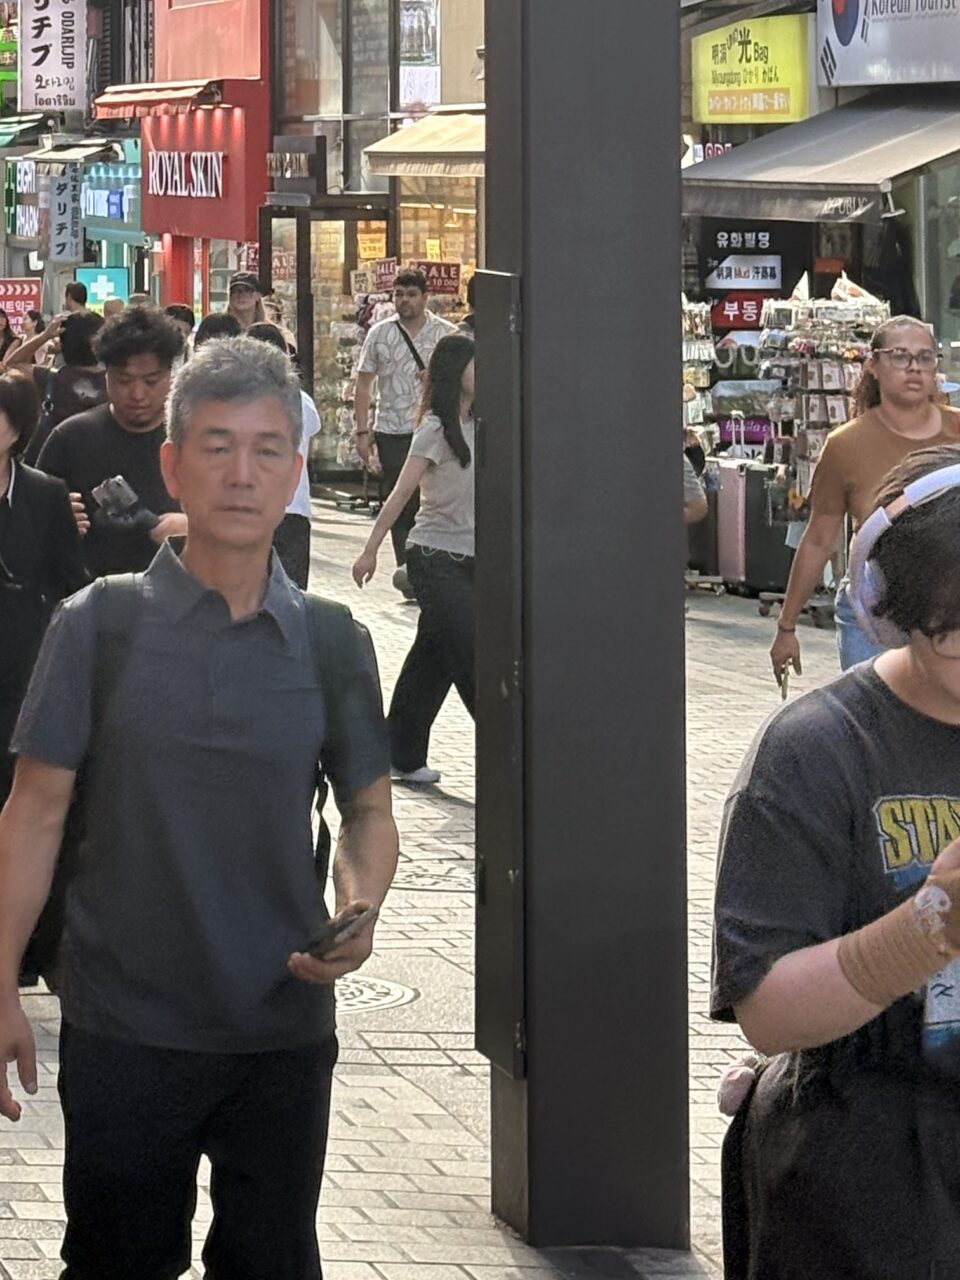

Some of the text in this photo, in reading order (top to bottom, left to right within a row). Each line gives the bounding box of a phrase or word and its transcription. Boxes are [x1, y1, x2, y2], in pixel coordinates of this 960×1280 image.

[737, 26, 753, 64] 光
[753, 42, 769, 65] Bag
[148, 150, 190, 197] ROYAL
[190, 151, 224, 198] SKIN
[419, 265, 458, 279] SALE
[880, 798, 960, 869] STA
